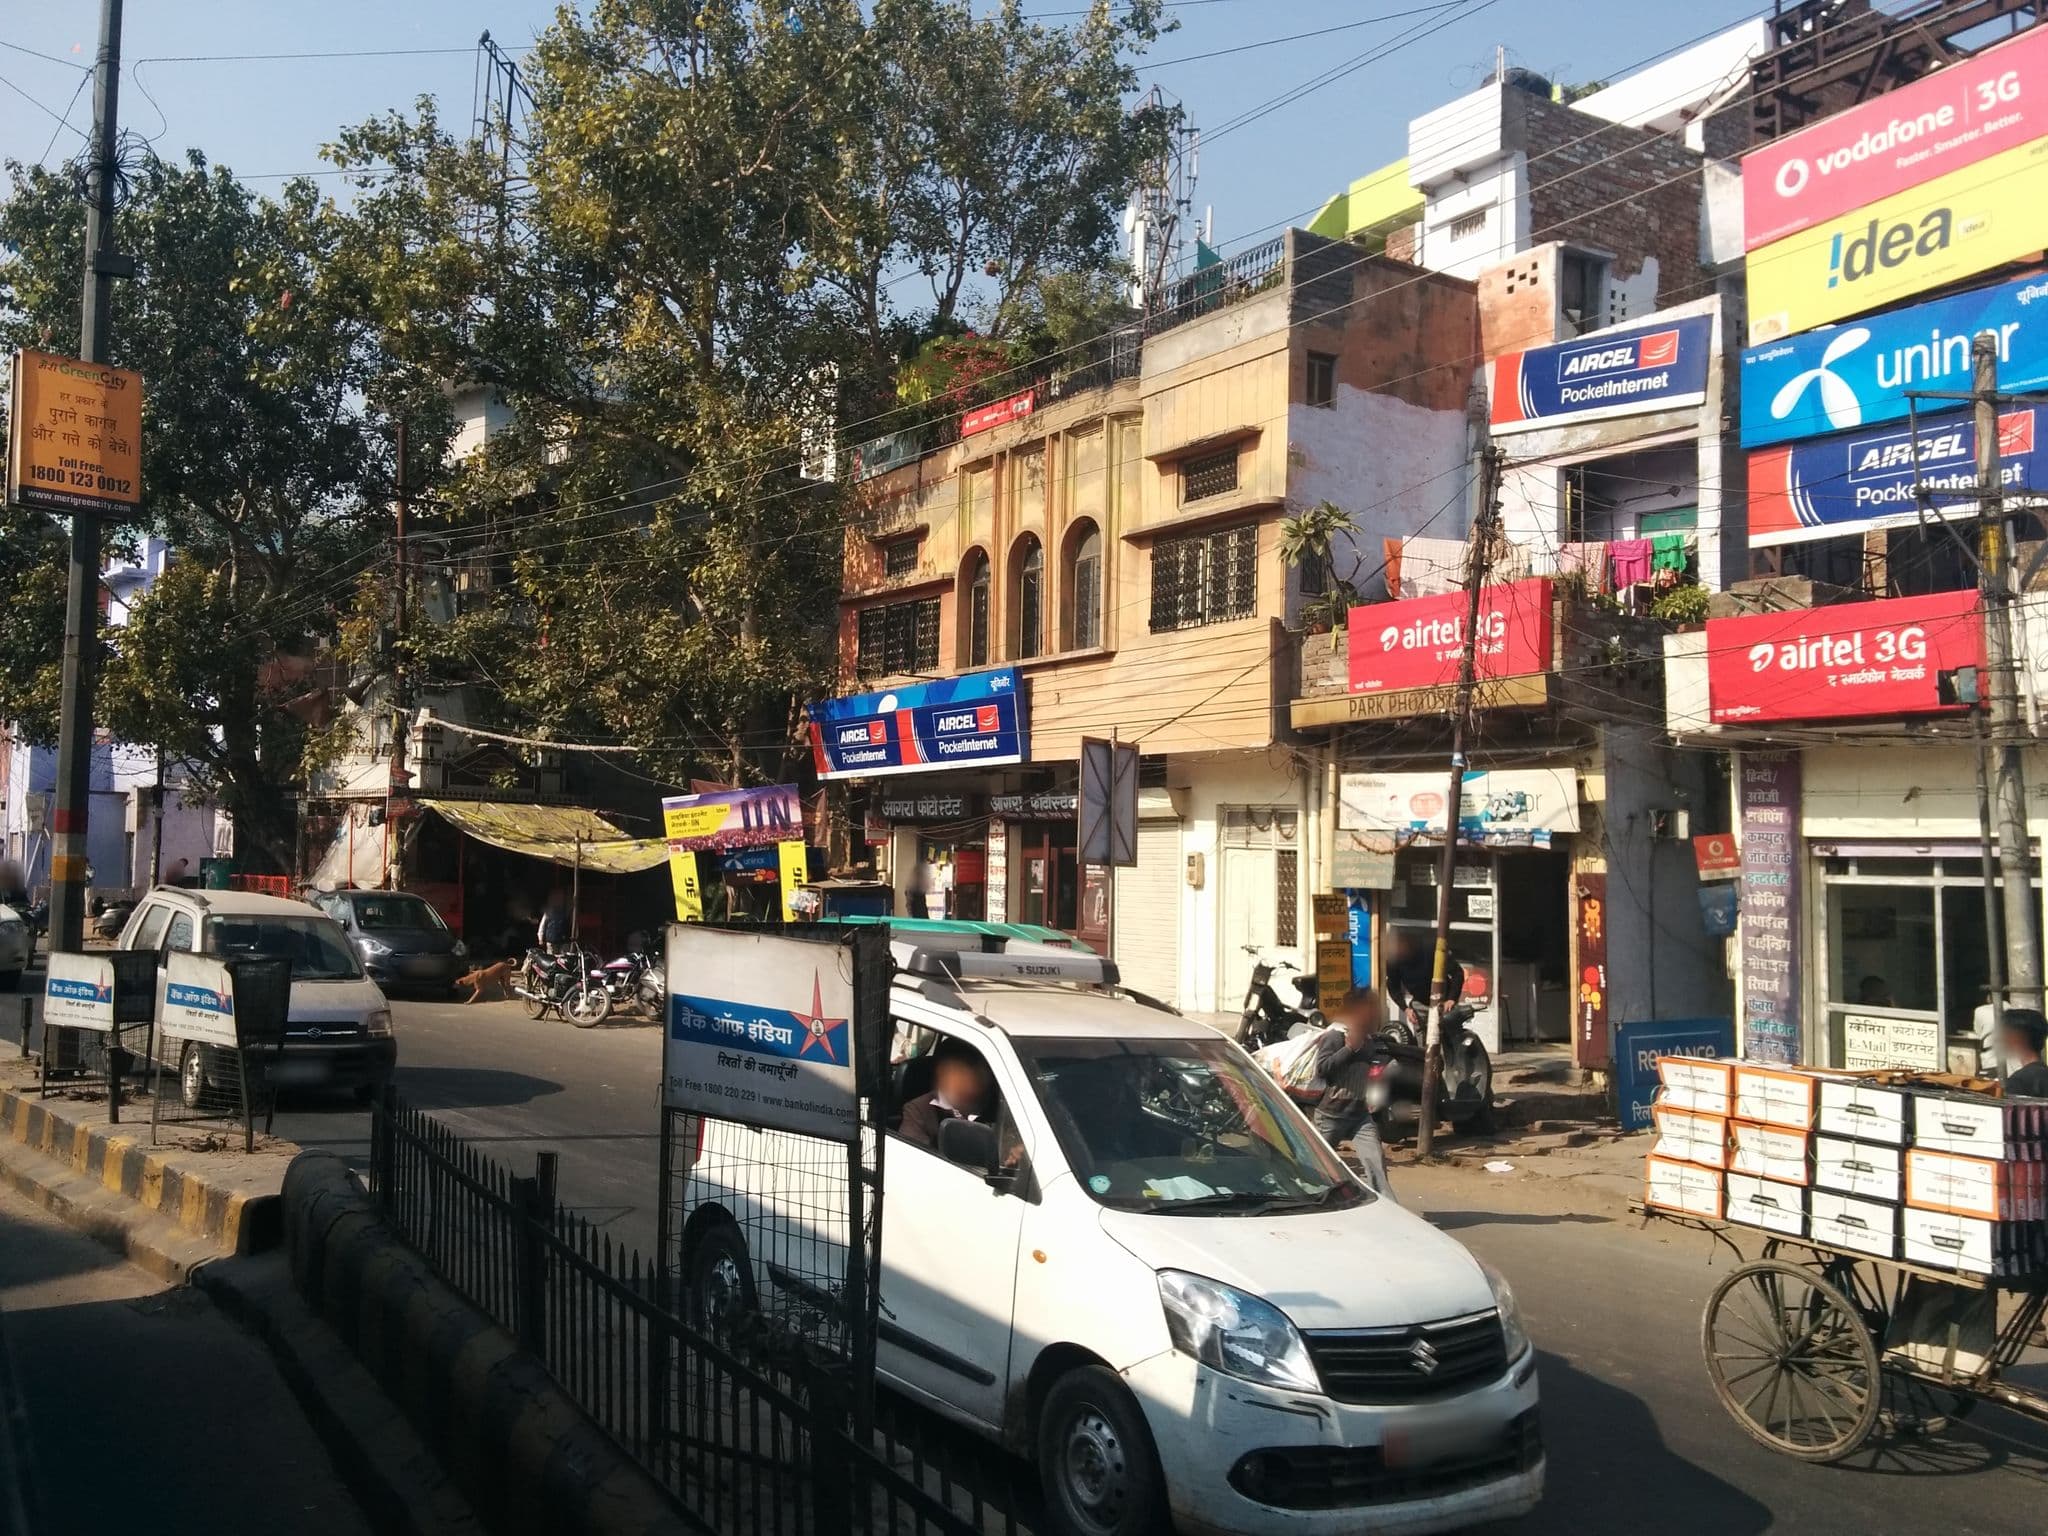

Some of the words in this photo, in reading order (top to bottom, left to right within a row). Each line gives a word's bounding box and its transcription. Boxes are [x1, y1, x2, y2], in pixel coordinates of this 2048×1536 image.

[1816, 103, 1955, 176] vodafone
[1975, 71, 2021, 113] 3G
[1564, 346, 1635, 376] AIRCEL
[1561, 372, 1669, 404] PocketInternet
[49, 407, 78, 425] पुराने
[31, 424, 55, 442] और
[1858, 433, 1967, 472] AIRCEL
[59, 456, 77, 469] Toll
[80, 460, 104, 474] Free:
[29, 465, 66, 483] 1800
[69, 471, 94, 488] 123
[97, 476, 131, 494] 0012
[27, 490, 131, 512] www.merigreencity.com
[1402, 615, 1462, 649] airtel
[1779, 632, 1865, 671] airtel
[1875, 627, 1926, 662] 3G
[1827, 675, 1838, 687] द
[1841, 668, 1886, 685] स्मार्टफोन
[1891, 664, 1926, 681] नेटवर्क
[1350, 695, 1387, 718] PARK
[938, 714, 976, 732] AIRCEL
[840, 727, 869, 744] AIRCEL
[938, 736, 998, 754] PocketInternet
[842, 749, 886, 764] PocketInternet
[741, 795, 792, 831] IIN
[881, 800, 914, 817] आगरा
[1025, 965, 1062, 976] SUZUKI
[681, 1007, 707, 1031] बैंक
[747, 1017, 793, 1046] इंडिया
[1849, 1039, 1886, 1053] E-Mail
[717, 1052, 742, 1071] रिश्तों
[744, 1056, 757, 1072] की
[685, 1078, 701, 1092] Free
[704, 1081, 723, 1097] 1800
[724, 1086, 739, 1099] 220
[741, 1089, 756, 1102] 229
